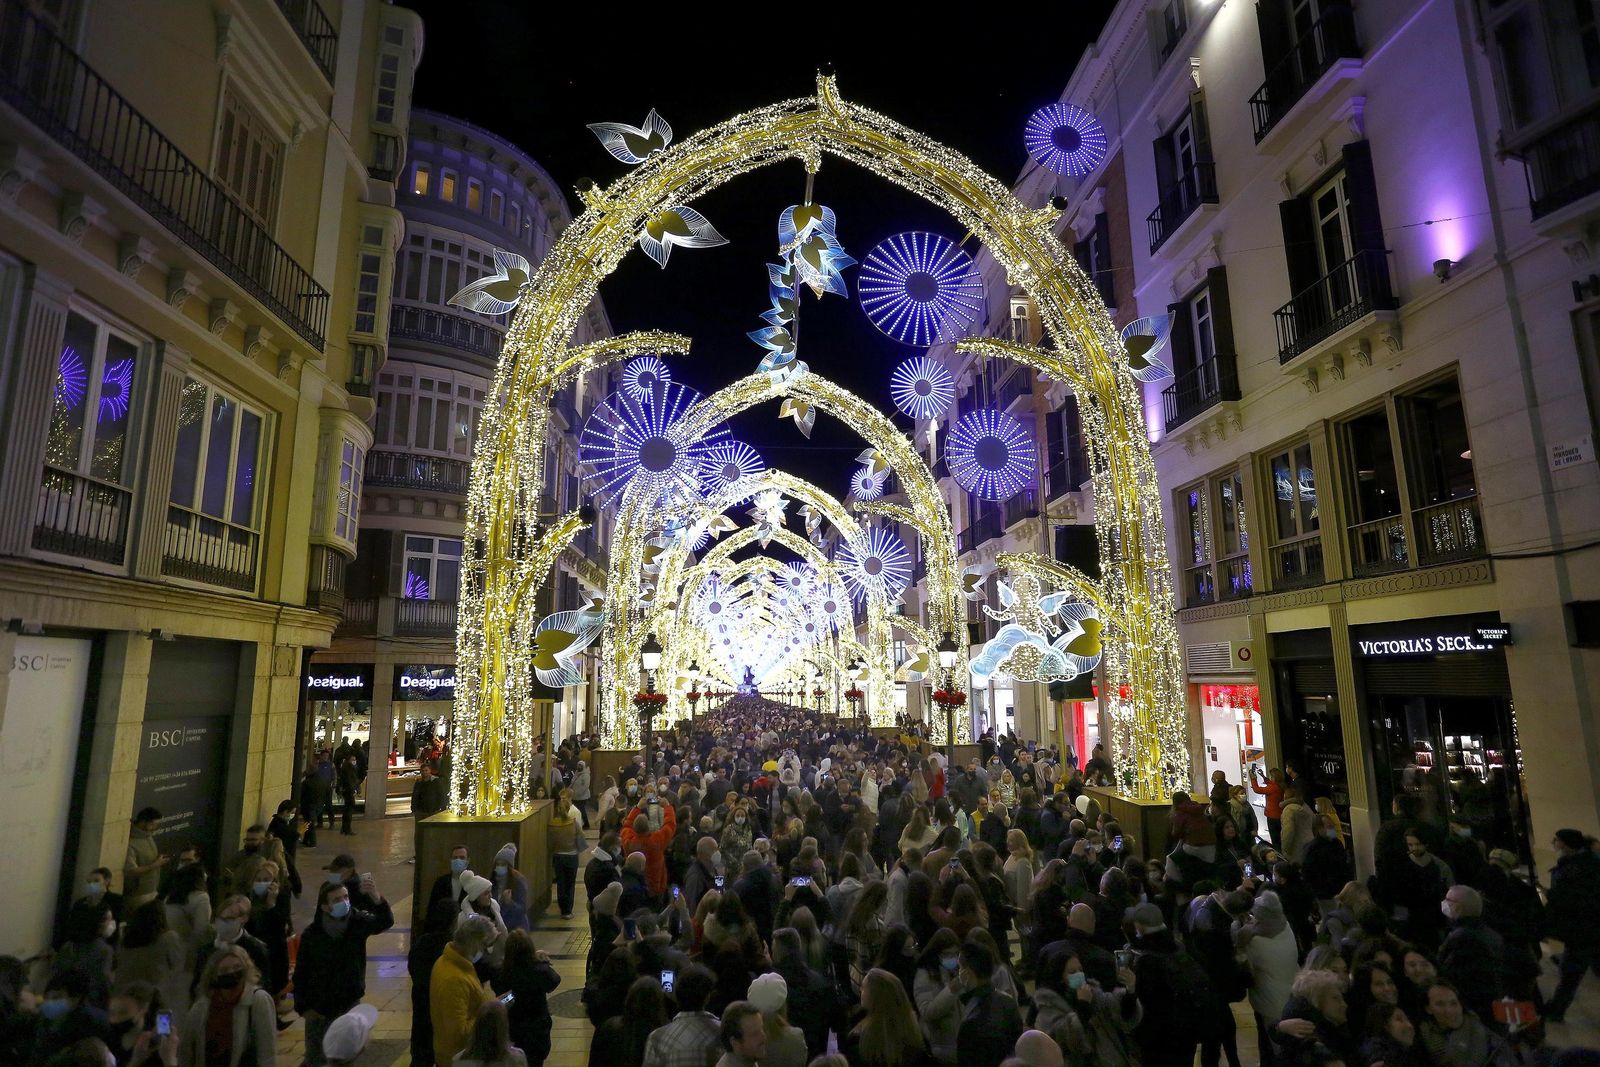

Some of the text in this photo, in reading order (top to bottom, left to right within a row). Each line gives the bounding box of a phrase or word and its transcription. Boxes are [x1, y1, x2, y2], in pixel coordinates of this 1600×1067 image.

[1359, 635, 1494, 655] VICTORIA'S SECR
[149, 729, 182, 748] BSC
